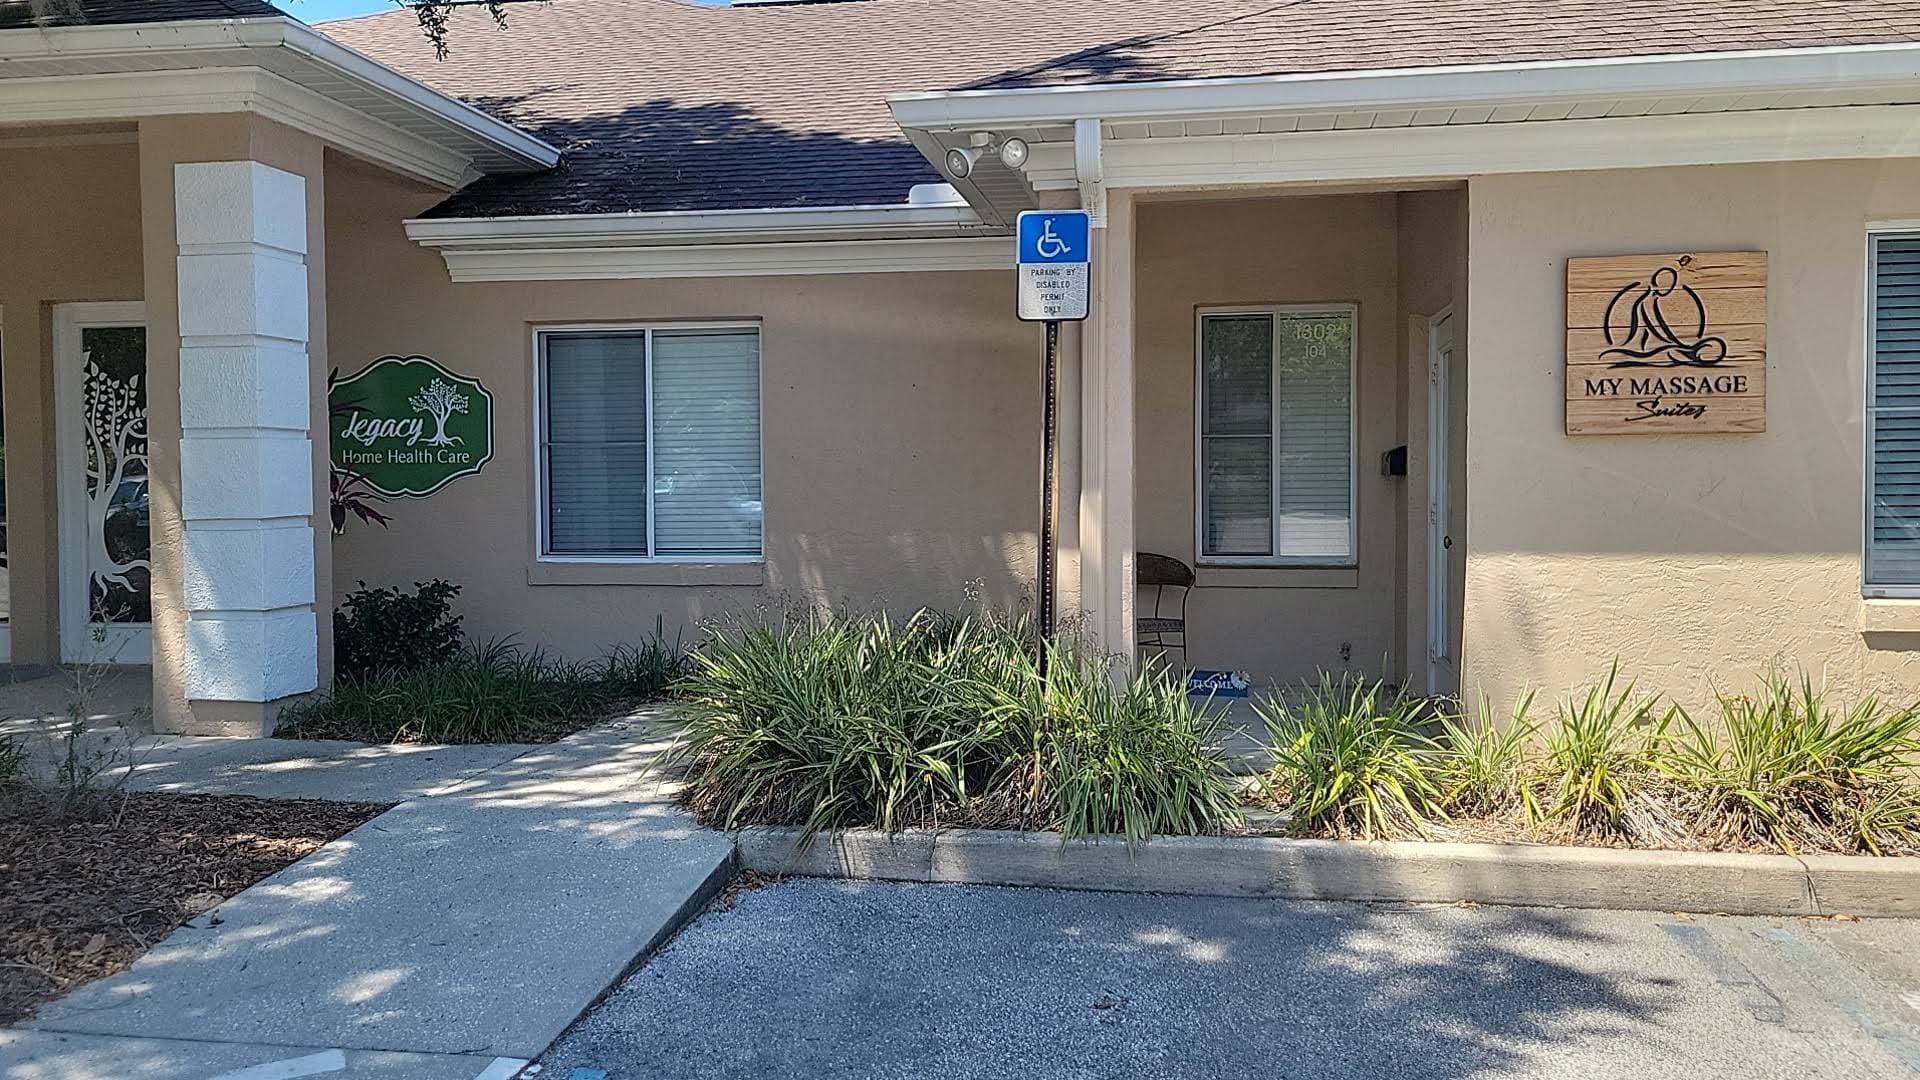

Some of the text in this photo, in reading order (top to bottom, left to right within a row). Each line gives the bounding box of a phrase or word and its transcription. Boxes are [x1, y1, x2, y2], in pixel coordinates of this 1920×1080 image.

[1031, 268, 1076, 277] PARKING BY
[1036, 281, 1071, 289] DISABLED
[1040, 293, 1065, 301] PERMIT
[1043, 305, 1061, 314] ONLY
[1304, 344, 1327, 358] 104
[1585, 376, 1748, 396] MY MASSAGE
[1625, 395, 1708, 422] Suites
[341, 411, 423, 446] Legacy
[342, 449, 470, 464] Home Health Care
